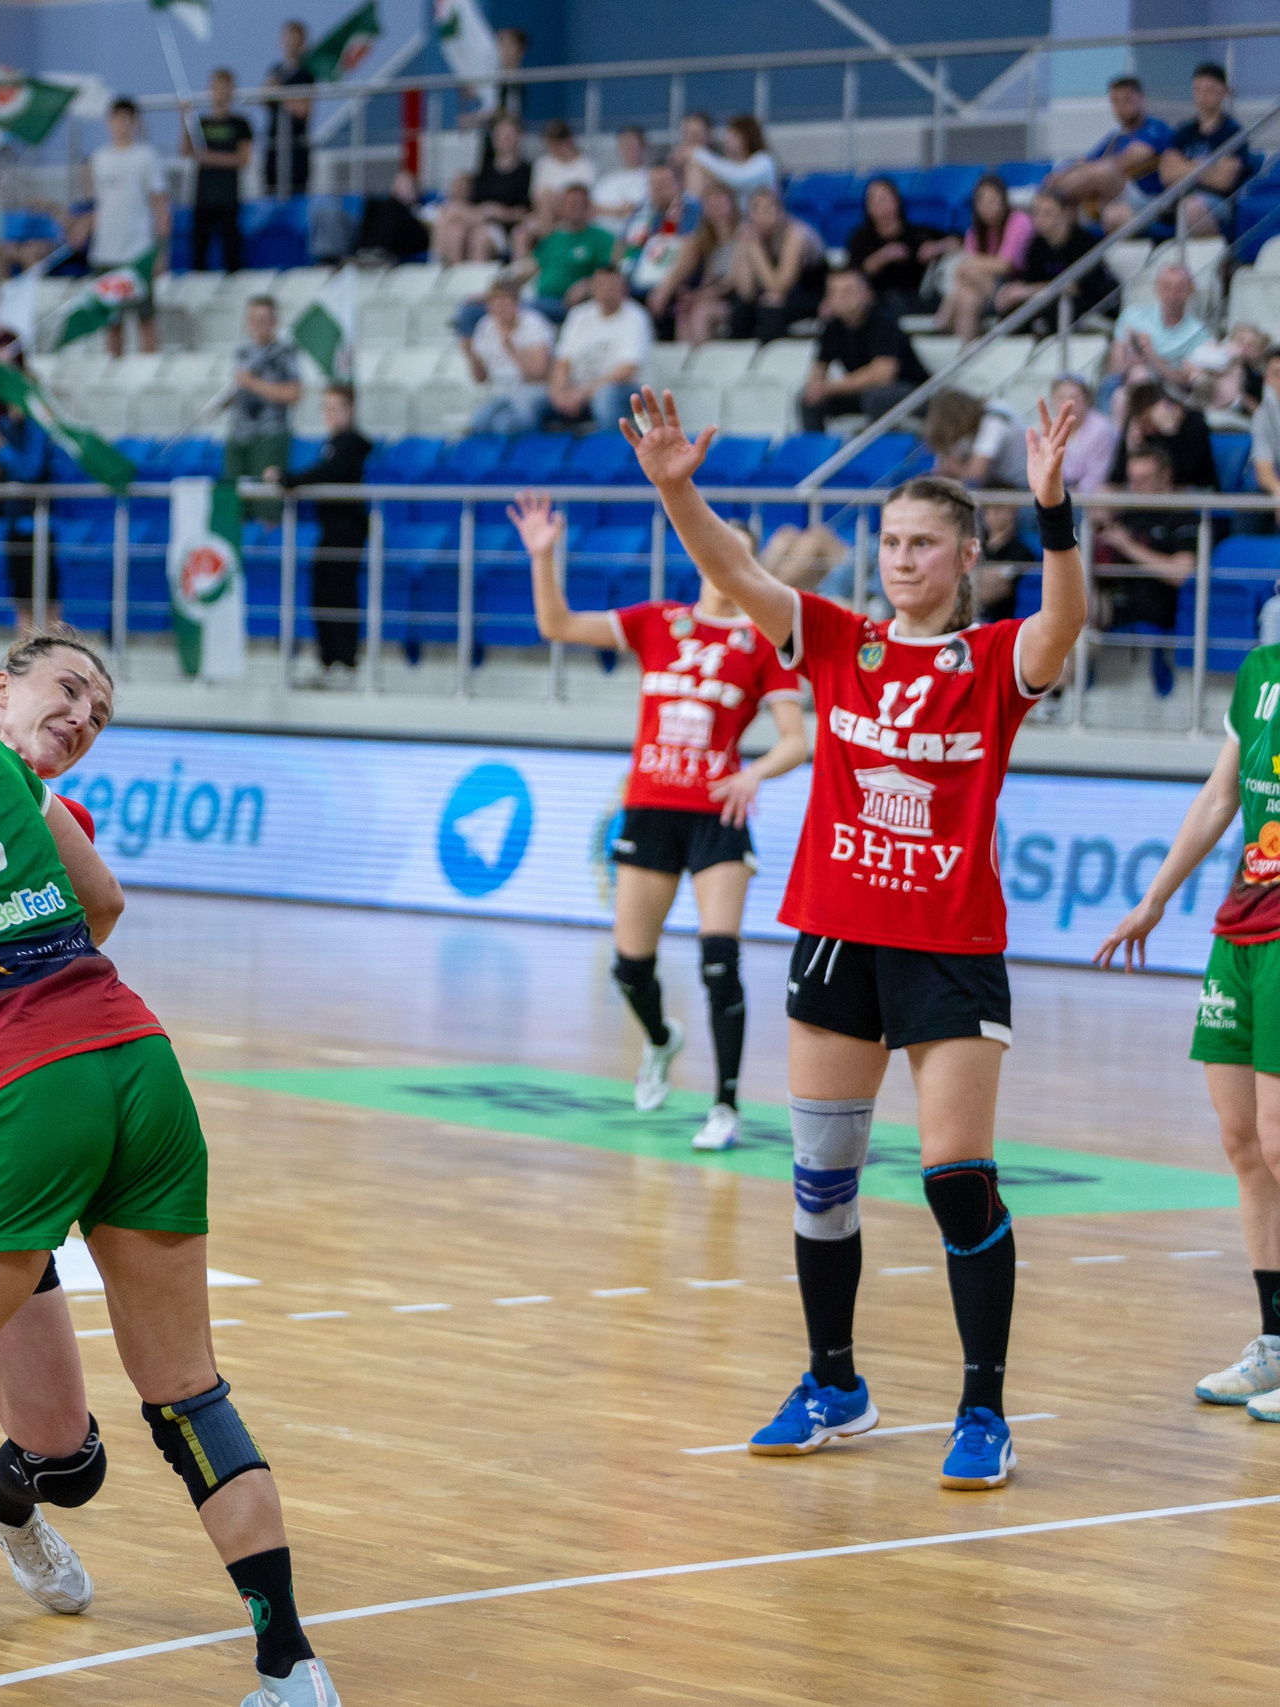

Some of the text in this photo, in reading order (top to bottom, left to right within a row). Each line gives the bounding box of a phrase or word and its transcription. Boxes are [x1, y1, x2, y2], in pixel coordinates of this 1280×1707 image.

[829, 705, 985, 763] BELAZ
[44, 759, 265, 859] region
[830, 822, 964, 881] БНТУ
[868, 873, 912, 893] 1920
